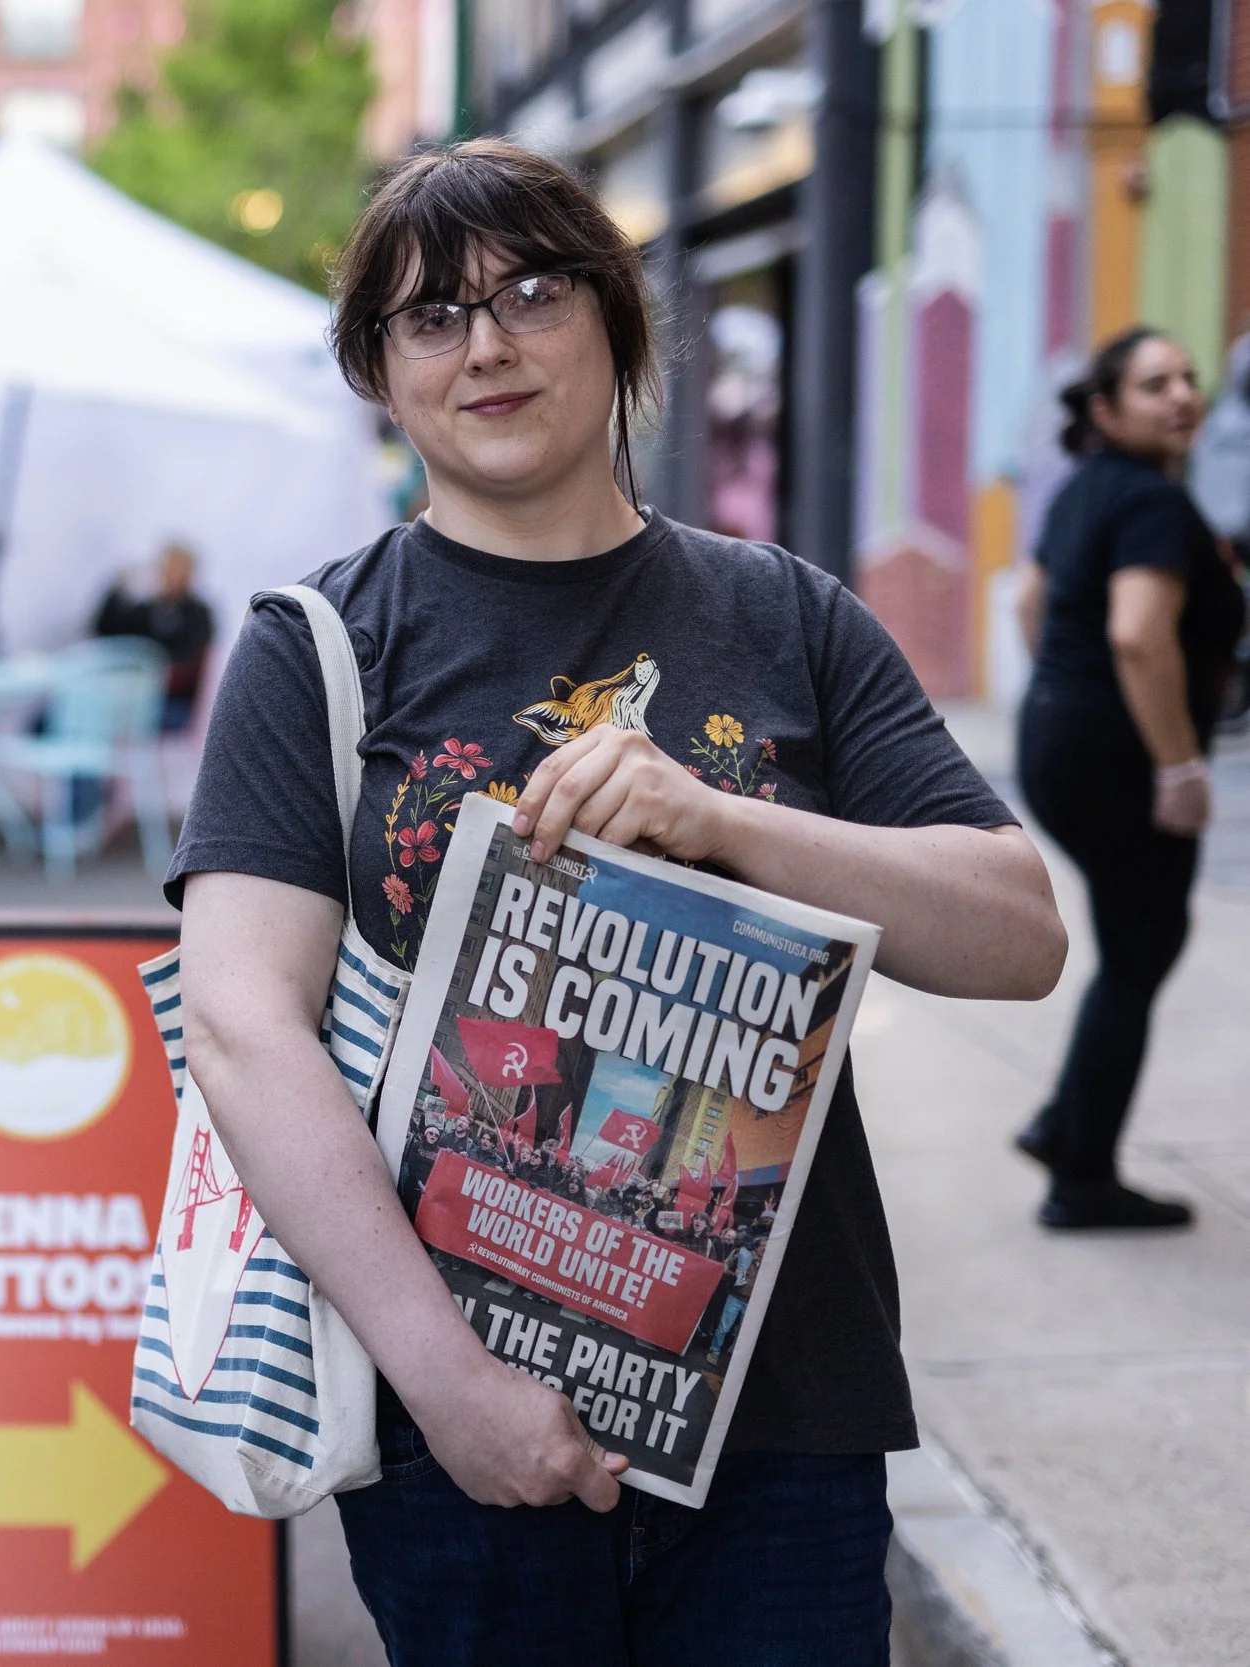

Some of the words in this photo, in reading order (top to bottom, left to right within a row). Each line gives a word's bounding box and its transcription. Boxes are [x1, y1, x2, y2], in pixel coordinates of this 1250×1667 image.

[490, 873, 820, 1041] REVOLUTION
[732, 920, 830, 965] COMMUNISTUSA.ORG
[467, 937, 537, 1019] IS
[544, 965, 800, 1113] COMING
[460, 1166, 583, 1242] WORKERS
[585, 1220, 625, 1258] OF
[628, 1236, 685, 1287] THE
[466, 1204, 556, 1267] WORLD
[558, 1245, 653, 1309] UNITE!
[477, 1246, 531, 1278] REVOLUTIONARY
[531, 1273, 580, 1301] COMMUNISTS
[581, 1293, 592, 1305] OF
[592, 1299, 628, 1322] AMERICA
[486, 1303, 562, 1369] THE
[564, 1334, 702, 1413] PARTY
[572, 1385, 641, 1441] FOR
[645, 1409, 688, 1455] IT
